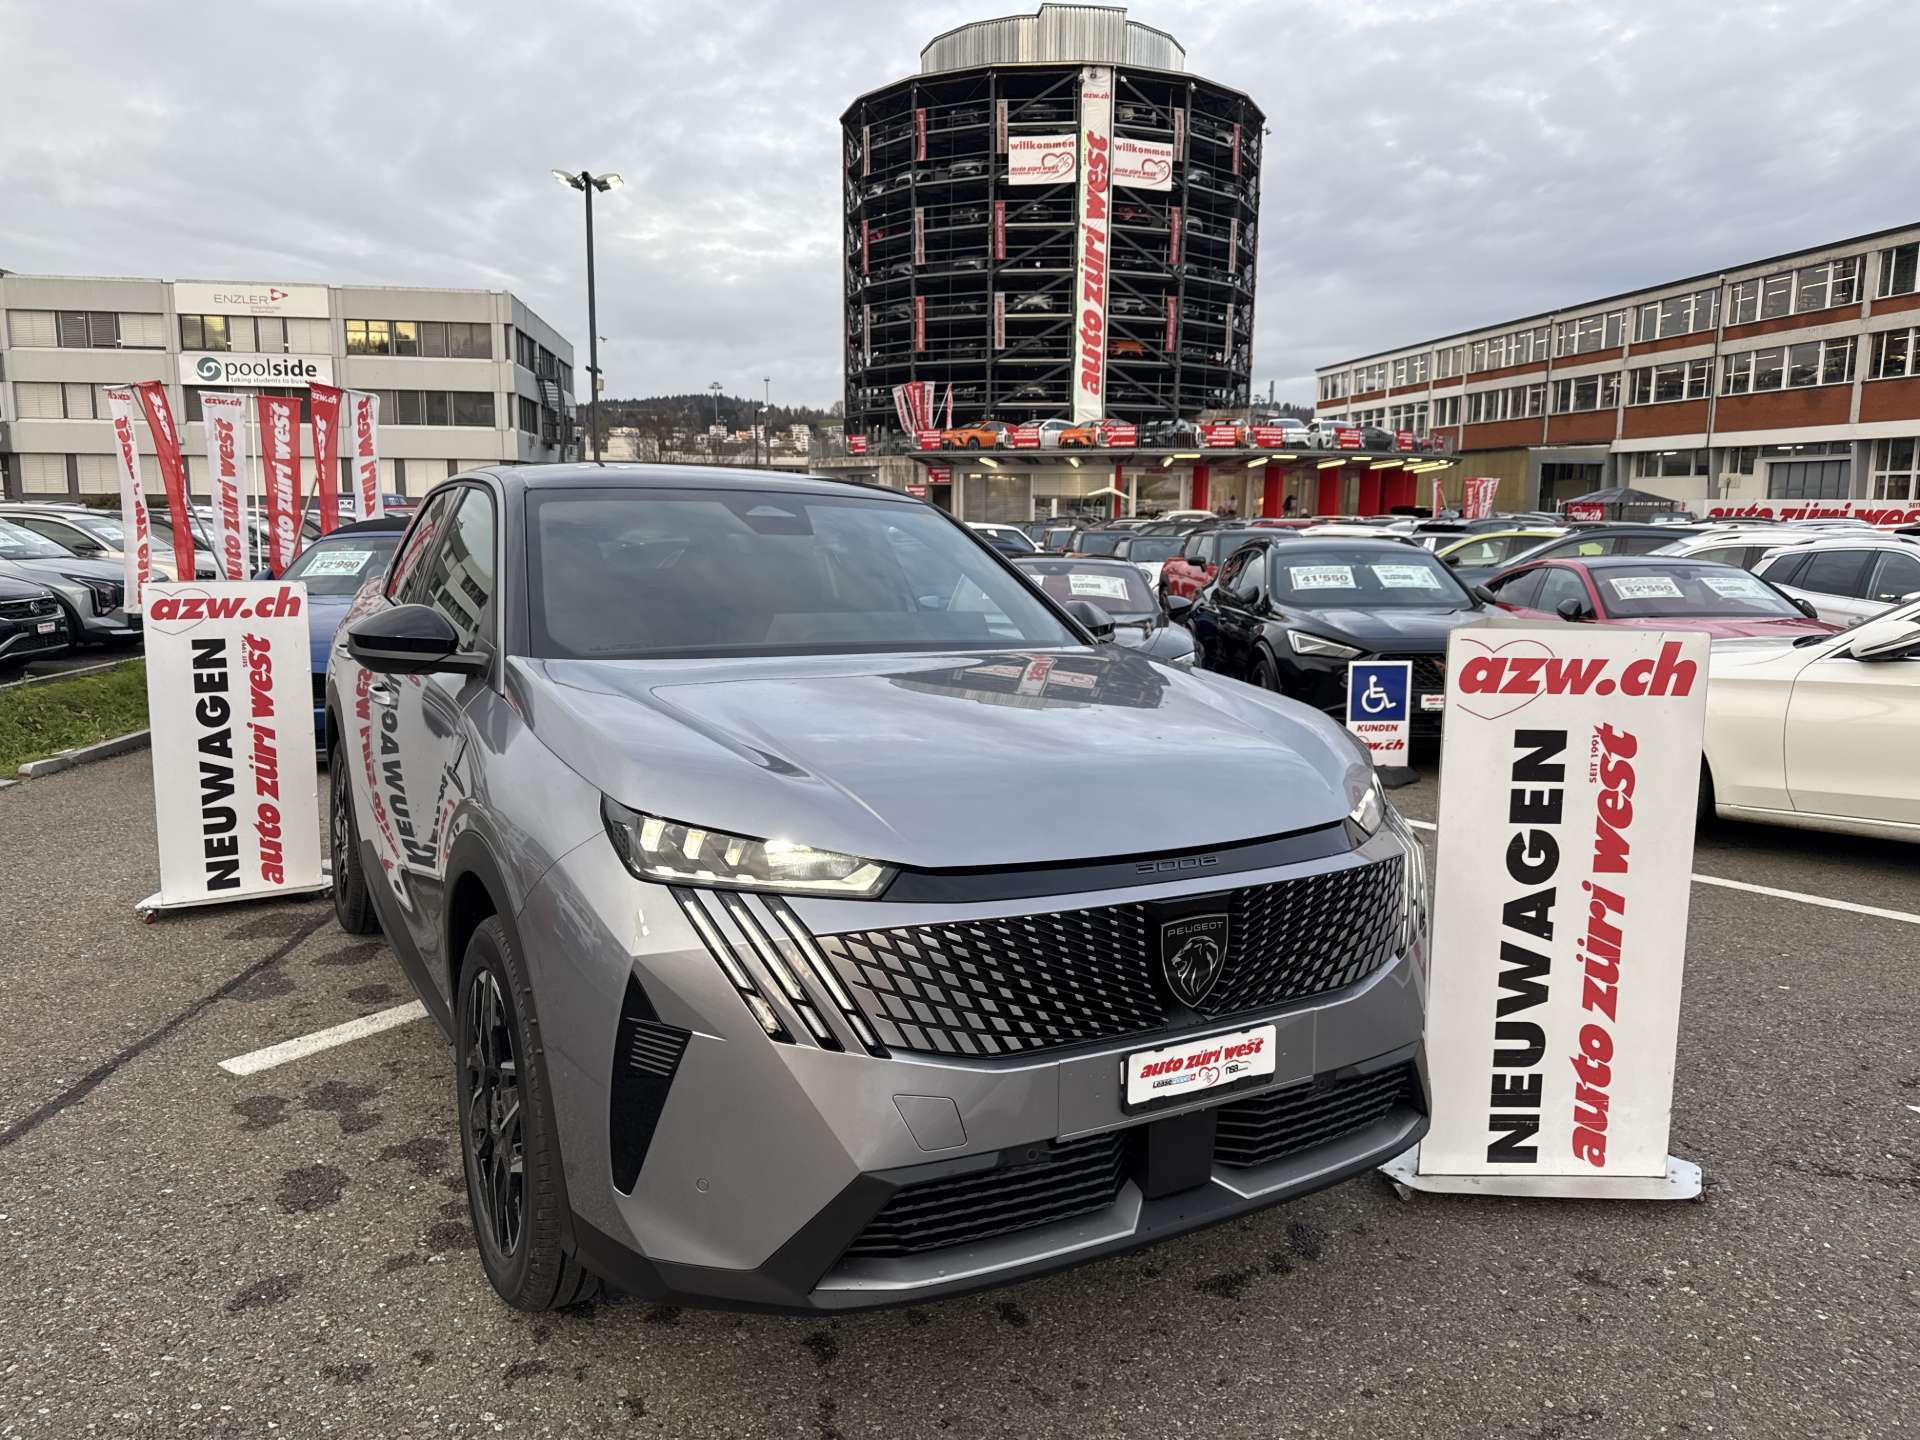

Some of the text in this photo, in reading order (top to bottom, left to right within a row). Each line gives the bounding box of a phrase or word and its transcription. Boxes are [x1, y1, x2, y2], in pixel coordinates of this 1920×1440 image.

[1011, 141, 1075, 150] willkommen
[1115, 143, 1171, 156] willkommen
[1081, 130, 1108, 396] auto züri west
[214, 294, 269, 305] ENZLER
[225, 359, 317, 382] poolside
[205, 397, 242, 407] azw.ch
[214, 417, 237, 477] west
[269, 402, 292, 460] west
[216, 478, 241, 534] züri
[272, 461, 294, 514] züri
[1302, 574, 1349, 583] 41'550
[150, 586, 300, 621] azw.ch
[1458, 640, 1697, 696] azw.ch
[1356, 724, 1399, 733] KUNDEN
[1367, 738, 1405, 751] w.ch
[191, 638, 241, 892] NEUWAGEN
[242, 632, 285, 885] auto züri west
[1589, 733, 1601, 784] SEIT 1991
[1167, 921, 1224, 938] PEUGEOT
[1486, 729, 1569, 1164] NEUWAGEN
[1568, 722, 1639, 1168] auto züri west
[1140, 1038, 1264, 1079] auto züri west
